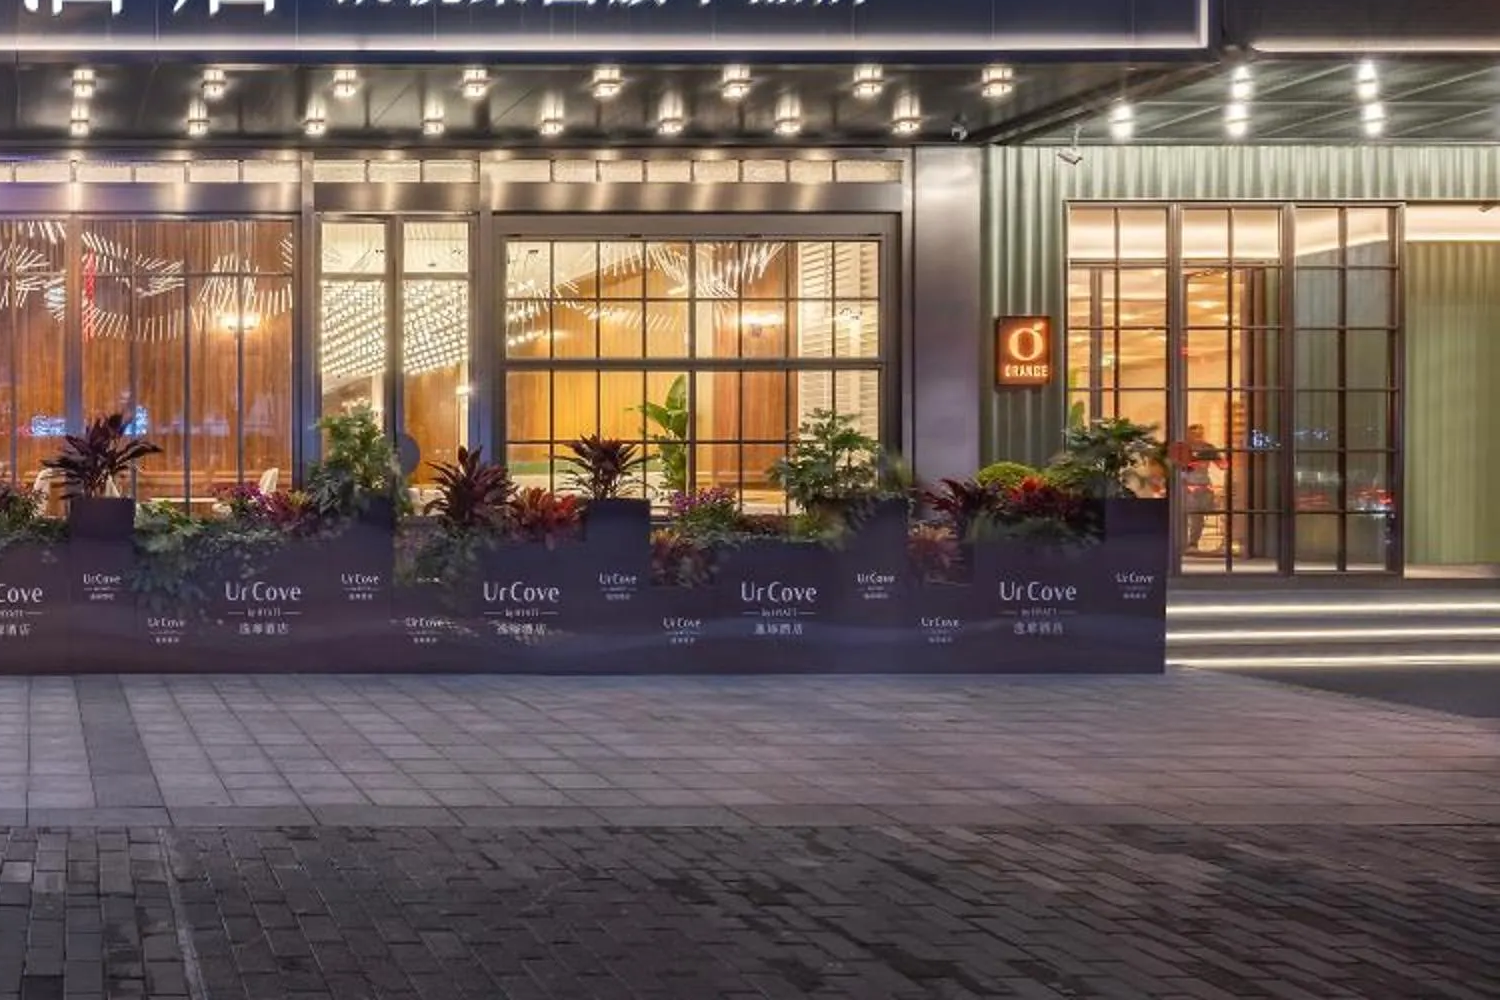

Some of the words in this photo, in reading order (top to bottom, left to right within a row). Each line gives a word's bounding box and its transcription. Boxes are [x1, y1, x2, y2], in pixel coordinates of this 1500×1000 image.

[225, 581, 302, 601] UrCove
[483, 581, 560, 602] UrCove
[741, 581, 817, 602] UrCove
[999, 581, 1077, 601] UrCove
